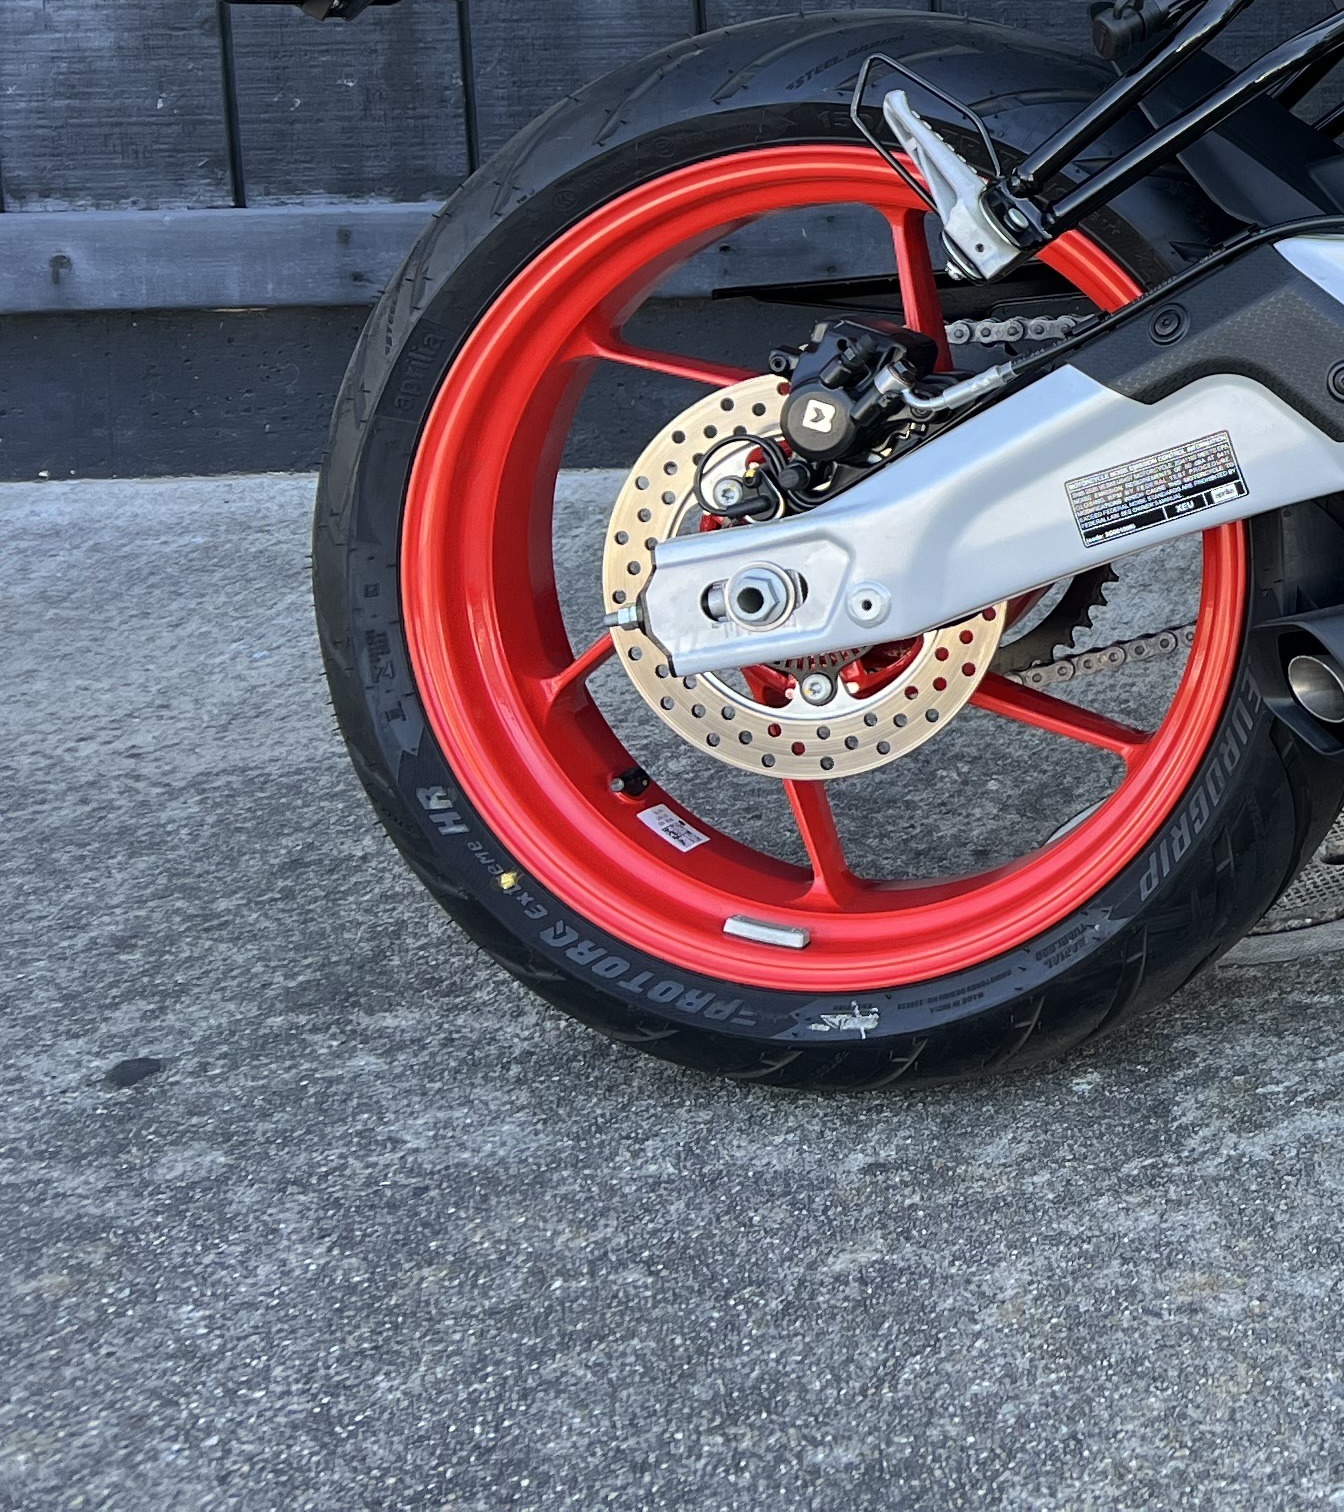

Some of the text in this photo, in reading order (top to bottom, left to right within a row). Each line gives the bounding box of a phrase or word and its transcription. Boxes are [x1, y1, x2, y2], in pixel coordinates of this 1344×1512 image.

[390, 330, 447, 410] aprilia
[1174, 499, 1195, 513] XEU
[415, 781, 470, 836] HR
[1123, 666, 1272, 902] EUROGRIP
[544, 918, 736, 1020] PROTORQ
